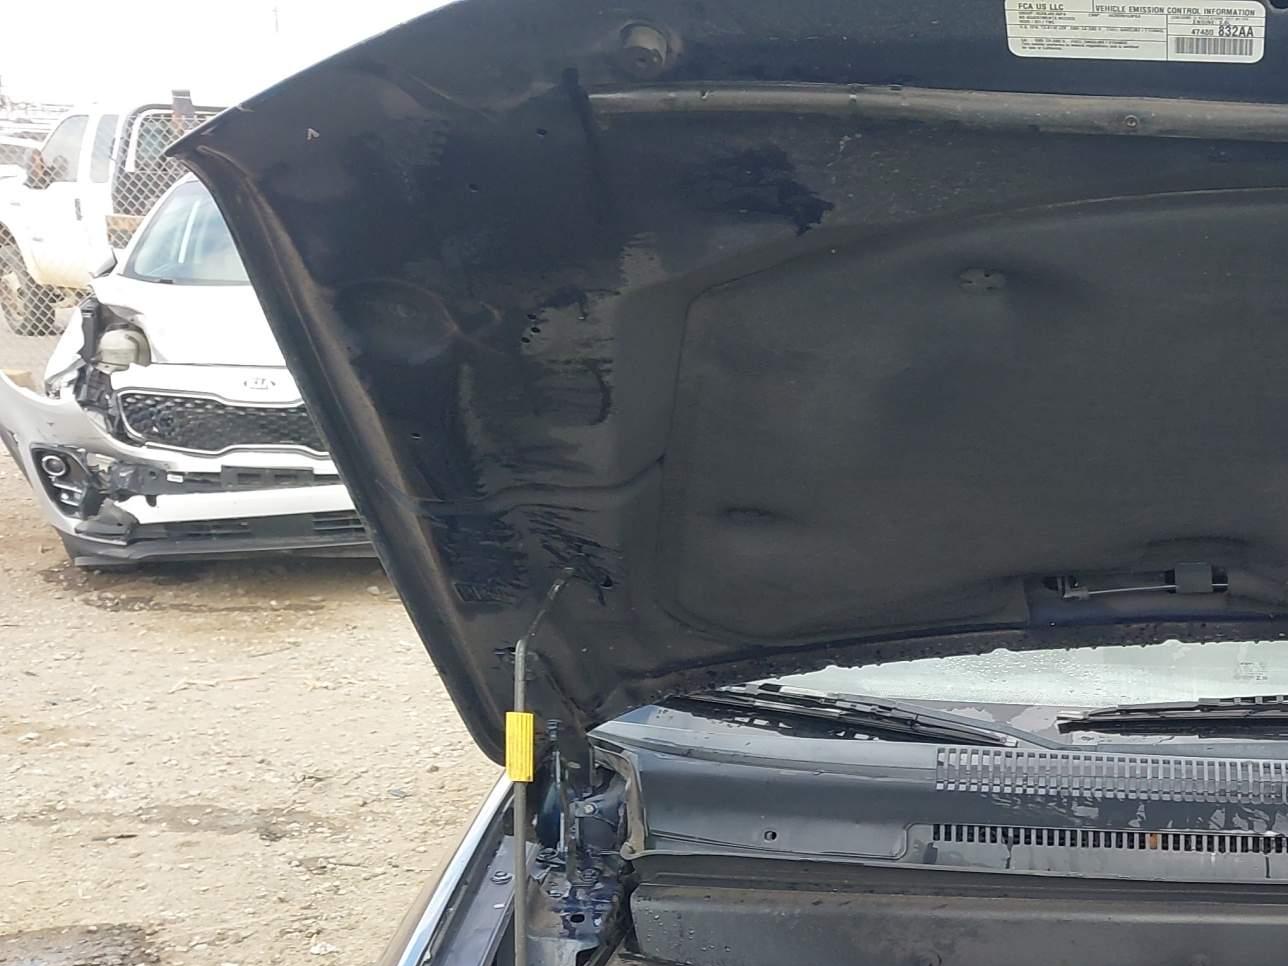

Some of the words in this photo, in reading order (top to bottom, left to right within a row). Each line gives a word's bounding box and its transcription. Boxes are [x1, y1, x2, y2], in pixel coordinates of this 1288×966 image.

[1049, 3, 1064, 11] LLC
[1167, 7, 1201, 15] CONTROL
[1203, 8, 1255, 16] INFORMATION
[1218, 25, 1254, 37] 832AA
